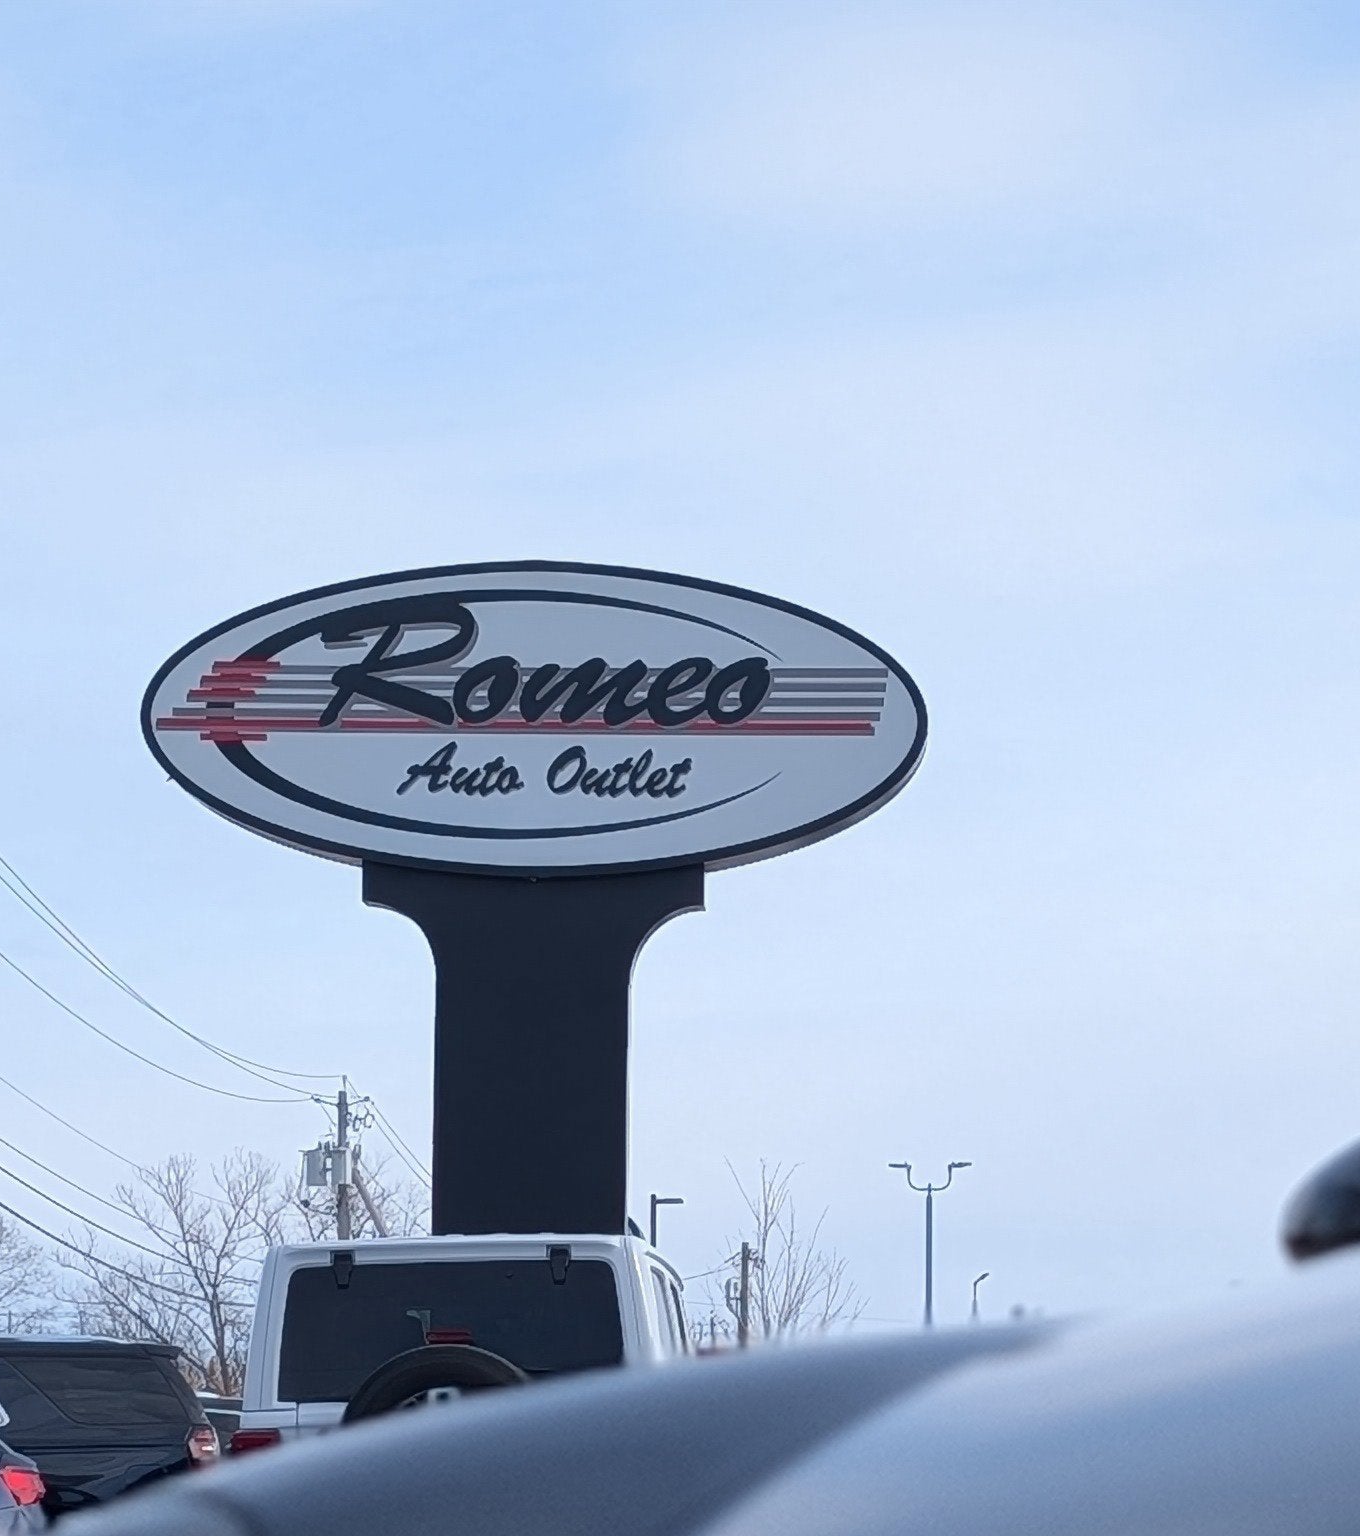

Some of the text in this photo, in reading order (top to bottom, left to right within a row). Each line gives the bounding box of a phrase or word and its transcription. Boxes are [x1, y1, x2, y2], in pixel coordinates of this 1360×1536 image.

[318, 600, 774, 729] Romeo
[396, 741, 692, 798] Auto Outlet
